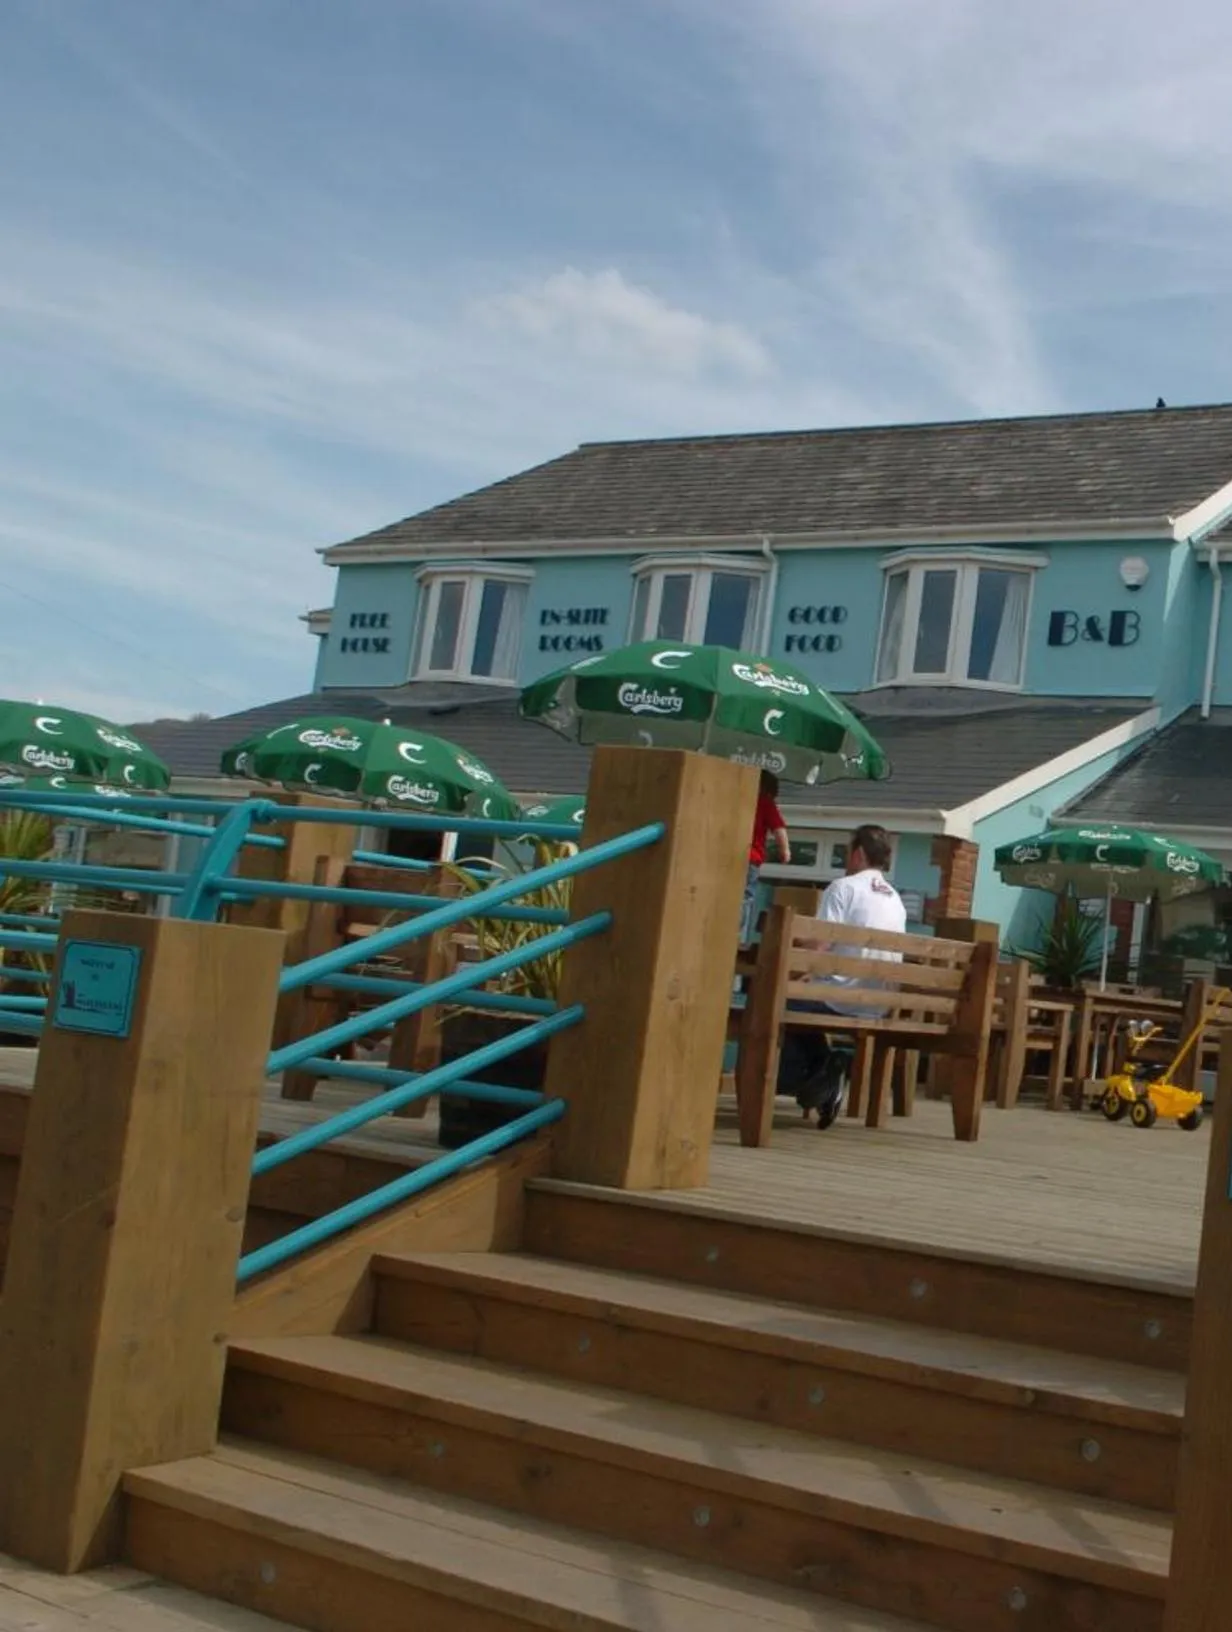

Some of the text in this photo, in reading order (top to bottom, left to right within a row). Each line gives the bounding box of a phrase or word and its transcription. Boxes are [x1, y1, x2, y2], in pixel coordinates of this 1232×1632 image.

[349, 612, 390, 629] FREE
[540, 608, 609, 627] EN-SUITE
[788, 605, 847, 625] GOOD
[1047, 610, 1141, 647] B&B
[340, 637, 391, 653] HOUSE
[538, 634, 604, 651] ROOMS
[784, 634, 842, 652] FOOD
[733, 663, 810, 696] Carlsberg
[618, 682, 683, 713] Carlsberg
[299, 730, 362, 751] Carlsberg
[22, 745, 75, 770] Carlsberg
[387, 775, 440, 804] Carlsberg
